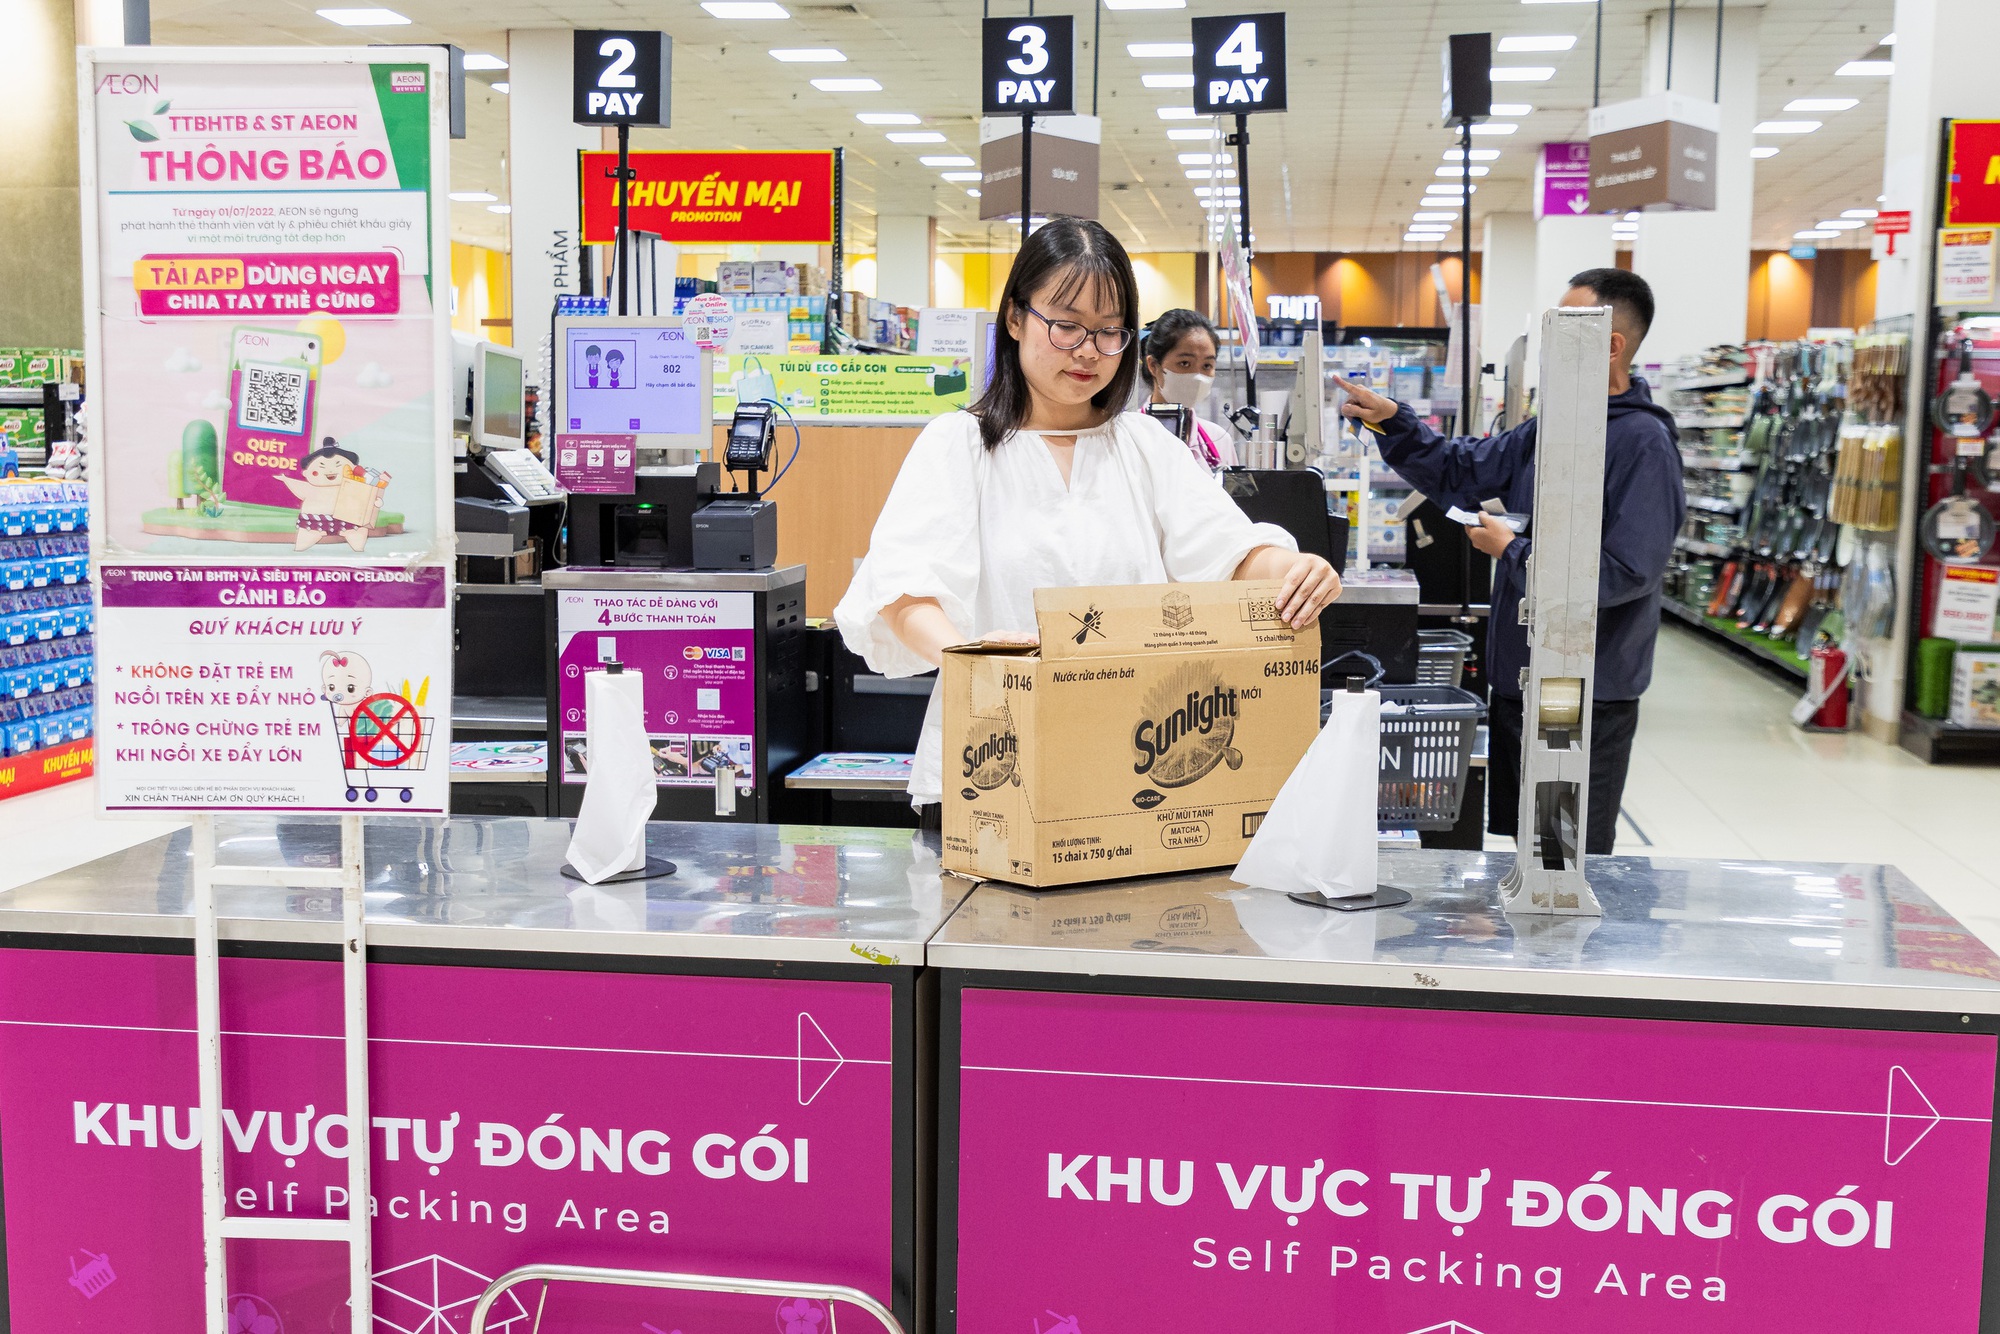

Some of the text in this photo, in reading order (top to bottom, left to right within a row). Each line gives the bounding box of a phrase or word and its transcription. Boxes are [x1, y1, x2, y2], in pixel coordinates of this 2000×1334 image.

[1006, 25, 1048, 75] 3
[1216, 22, 1264, 73] 4
[597, 38, 636, 88] 2
[997, 78, 1056, 104] PAY
[1208, 76, 1270, 104] PAY
[588, 91, 644, 116] PAY
[168, 114, 358, 131] TTBHTB & ST AEON
[140, 141, 388, 181] THÔNG BÁO
[611, 171, 802, 214] KHUYẾN MẠI
[278, 207, 307, 216] AEON
[670, 211, 742, 223] PROMOTION
[545, 230, 568, 288] PHẨM
[151, 261, 390, 285] TẢI APP DÙNG NGAY
[168, 289, 376, 310] CHIA TAY THẺ CỨNG
[663, 364, 681, 374] 802
[780, 359, 887, 375] TÚI DÙ ECO GẤP GỌN
[247, 437, 287, 454] QUÉT
[232, 451, 298, 471] QR CODE
[131, 568, 415, 585] TRUNG TÂM BHTH VÀ SIÊU THỊ AEON CELADON
[218, 583, 327, 605] CẢNH BÁO
[593, 596, 719, 609] THAO TÁC DỄ DÀNG VỚI
[189, 616, 364, 635] QUÝ KHÁCH LƯU Ý
[597, 608, 716, 627] 4 BƯỚC THANH TOÁN
[1255, 633, 1296, 643] 15 chai/thùng
[705, 648, 730, 658] VISA
[131, 661, 293, 682] KHÔNG ĐẶT TRẺ EM
[1052, 667, 1135, 683] Nước rửa chén bát
[1263, 659, 1319, 678] 64330146
[114, 685, 316, 705] NGỒI TRÊN XE ĐẨY NHỎ
[1240, 685, 1262, 700] MỚI
[131, 718, 321, 736] TRÔNG CHỪNG TRẺ EM
[1133, 685, 1238, 775] Sunlight
[43, 747, 80, 775] KHUYẾN
[80, 748, 94, 766] MẠ
[116, 741, 302, 762] KHI NGỒI XE ĐẨY LỚN
[962, 731, 1018, 779] Sunlight
[125, 794, 140, 802] XIN
[1135, 795, 1161, 804] BIO-CARE
[1156, 808, 1214, 822] KHỬ MÙI TANH
[1170, 825, 1201, 835] MATCHA
[1052, 836, 1102, 849] KHỐI LƯỢNG TỊNH:
[1168, 834, 1203, 847] TRÀ NHẬT
[1052, 845, 1133, 864] 15 chai x 750 g/chai
[73, 1100, 811, 1184] KHU VỰC TỰ ĐÓNG GÓI
[222, 1178, 298, 1212] elf
[555, 1197, 672, 1235] Area
[1046, 1151, 1894, 1251] KHU VỰC TỰ ĐÓNG GÓI
[1192, 1236, 1730, 1304] Self Packing Area
